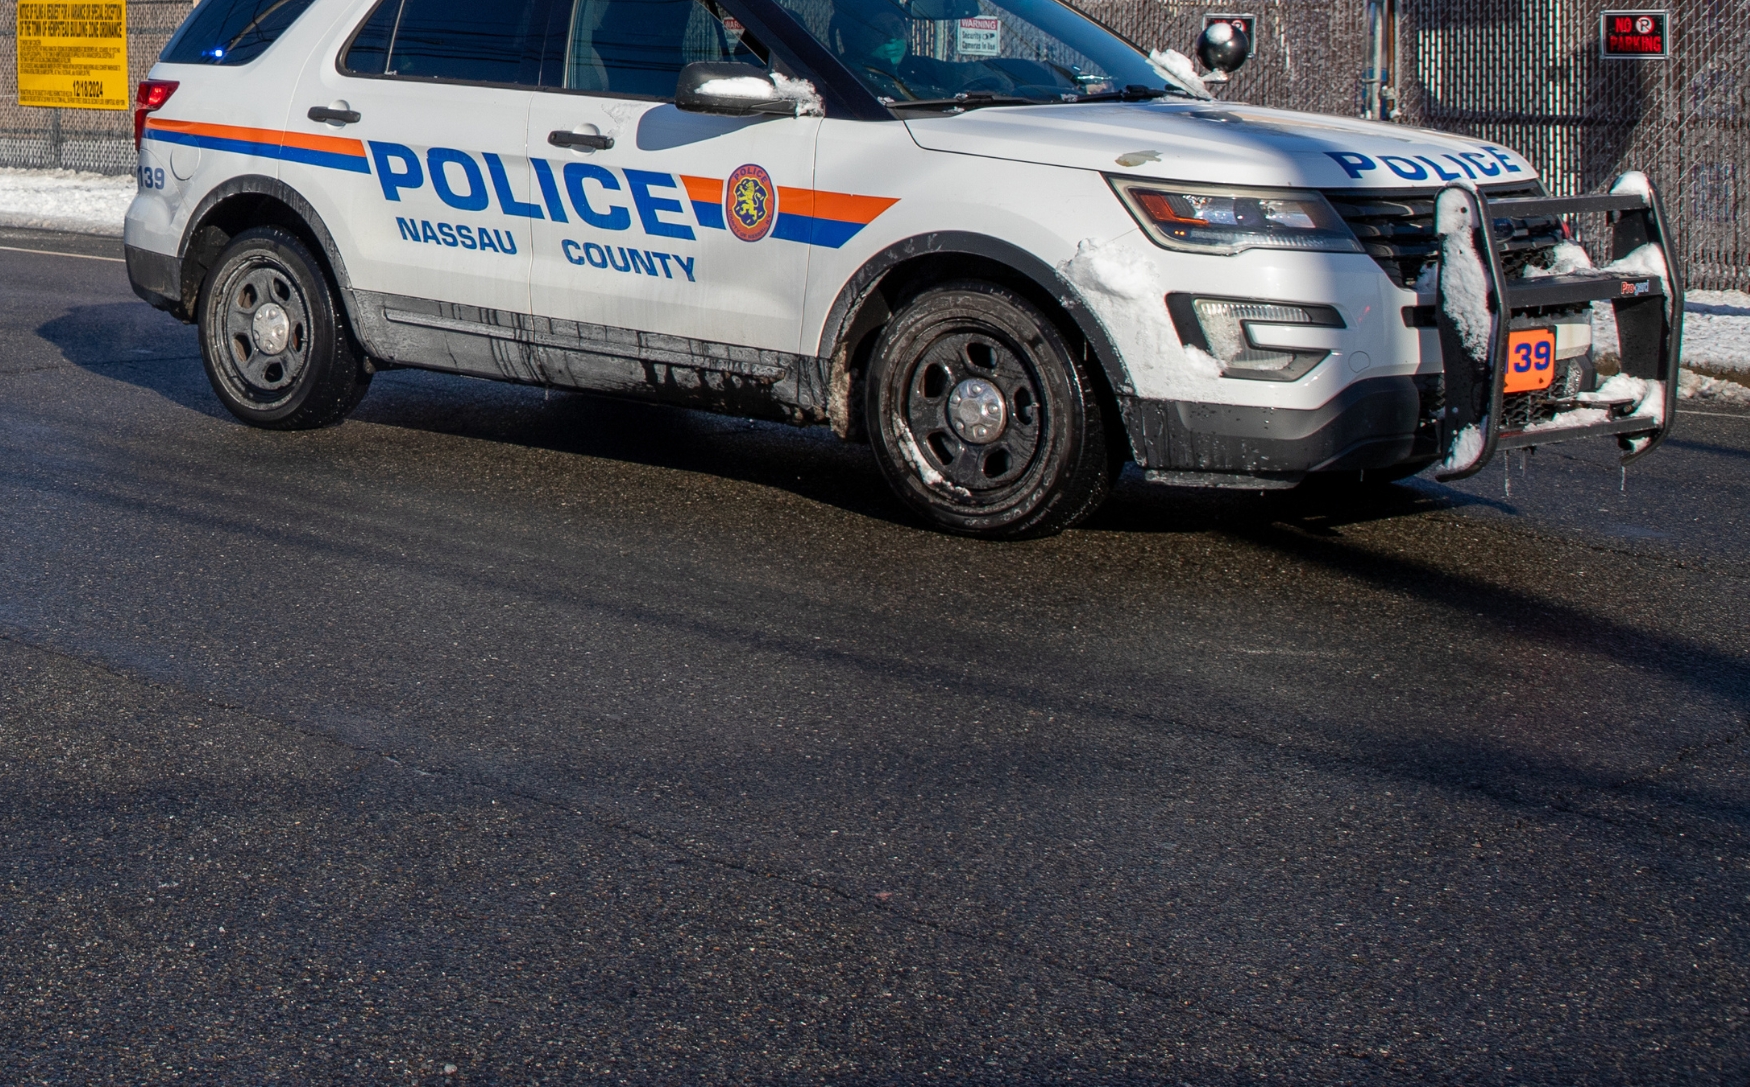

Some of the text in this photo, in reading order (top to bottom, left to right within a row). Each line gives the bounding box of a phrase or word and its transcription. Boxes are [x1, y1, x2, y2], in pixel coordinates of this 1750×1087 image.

[961, 18, 996, 30] WARNING
[1615, 16, 1633, 33] NO
[1610, 35, 1662, 53] PARKING
[733, 167, 768, 184] POLICE
[1323, 146, 1522, 181] POLICE
[137, 165, 165, 190] 139
[367, 140, 697, 241] POLICE
[395, 216, 696, 283] NASSAU COUNTY
[1505, 341, 1551, 374] 39
